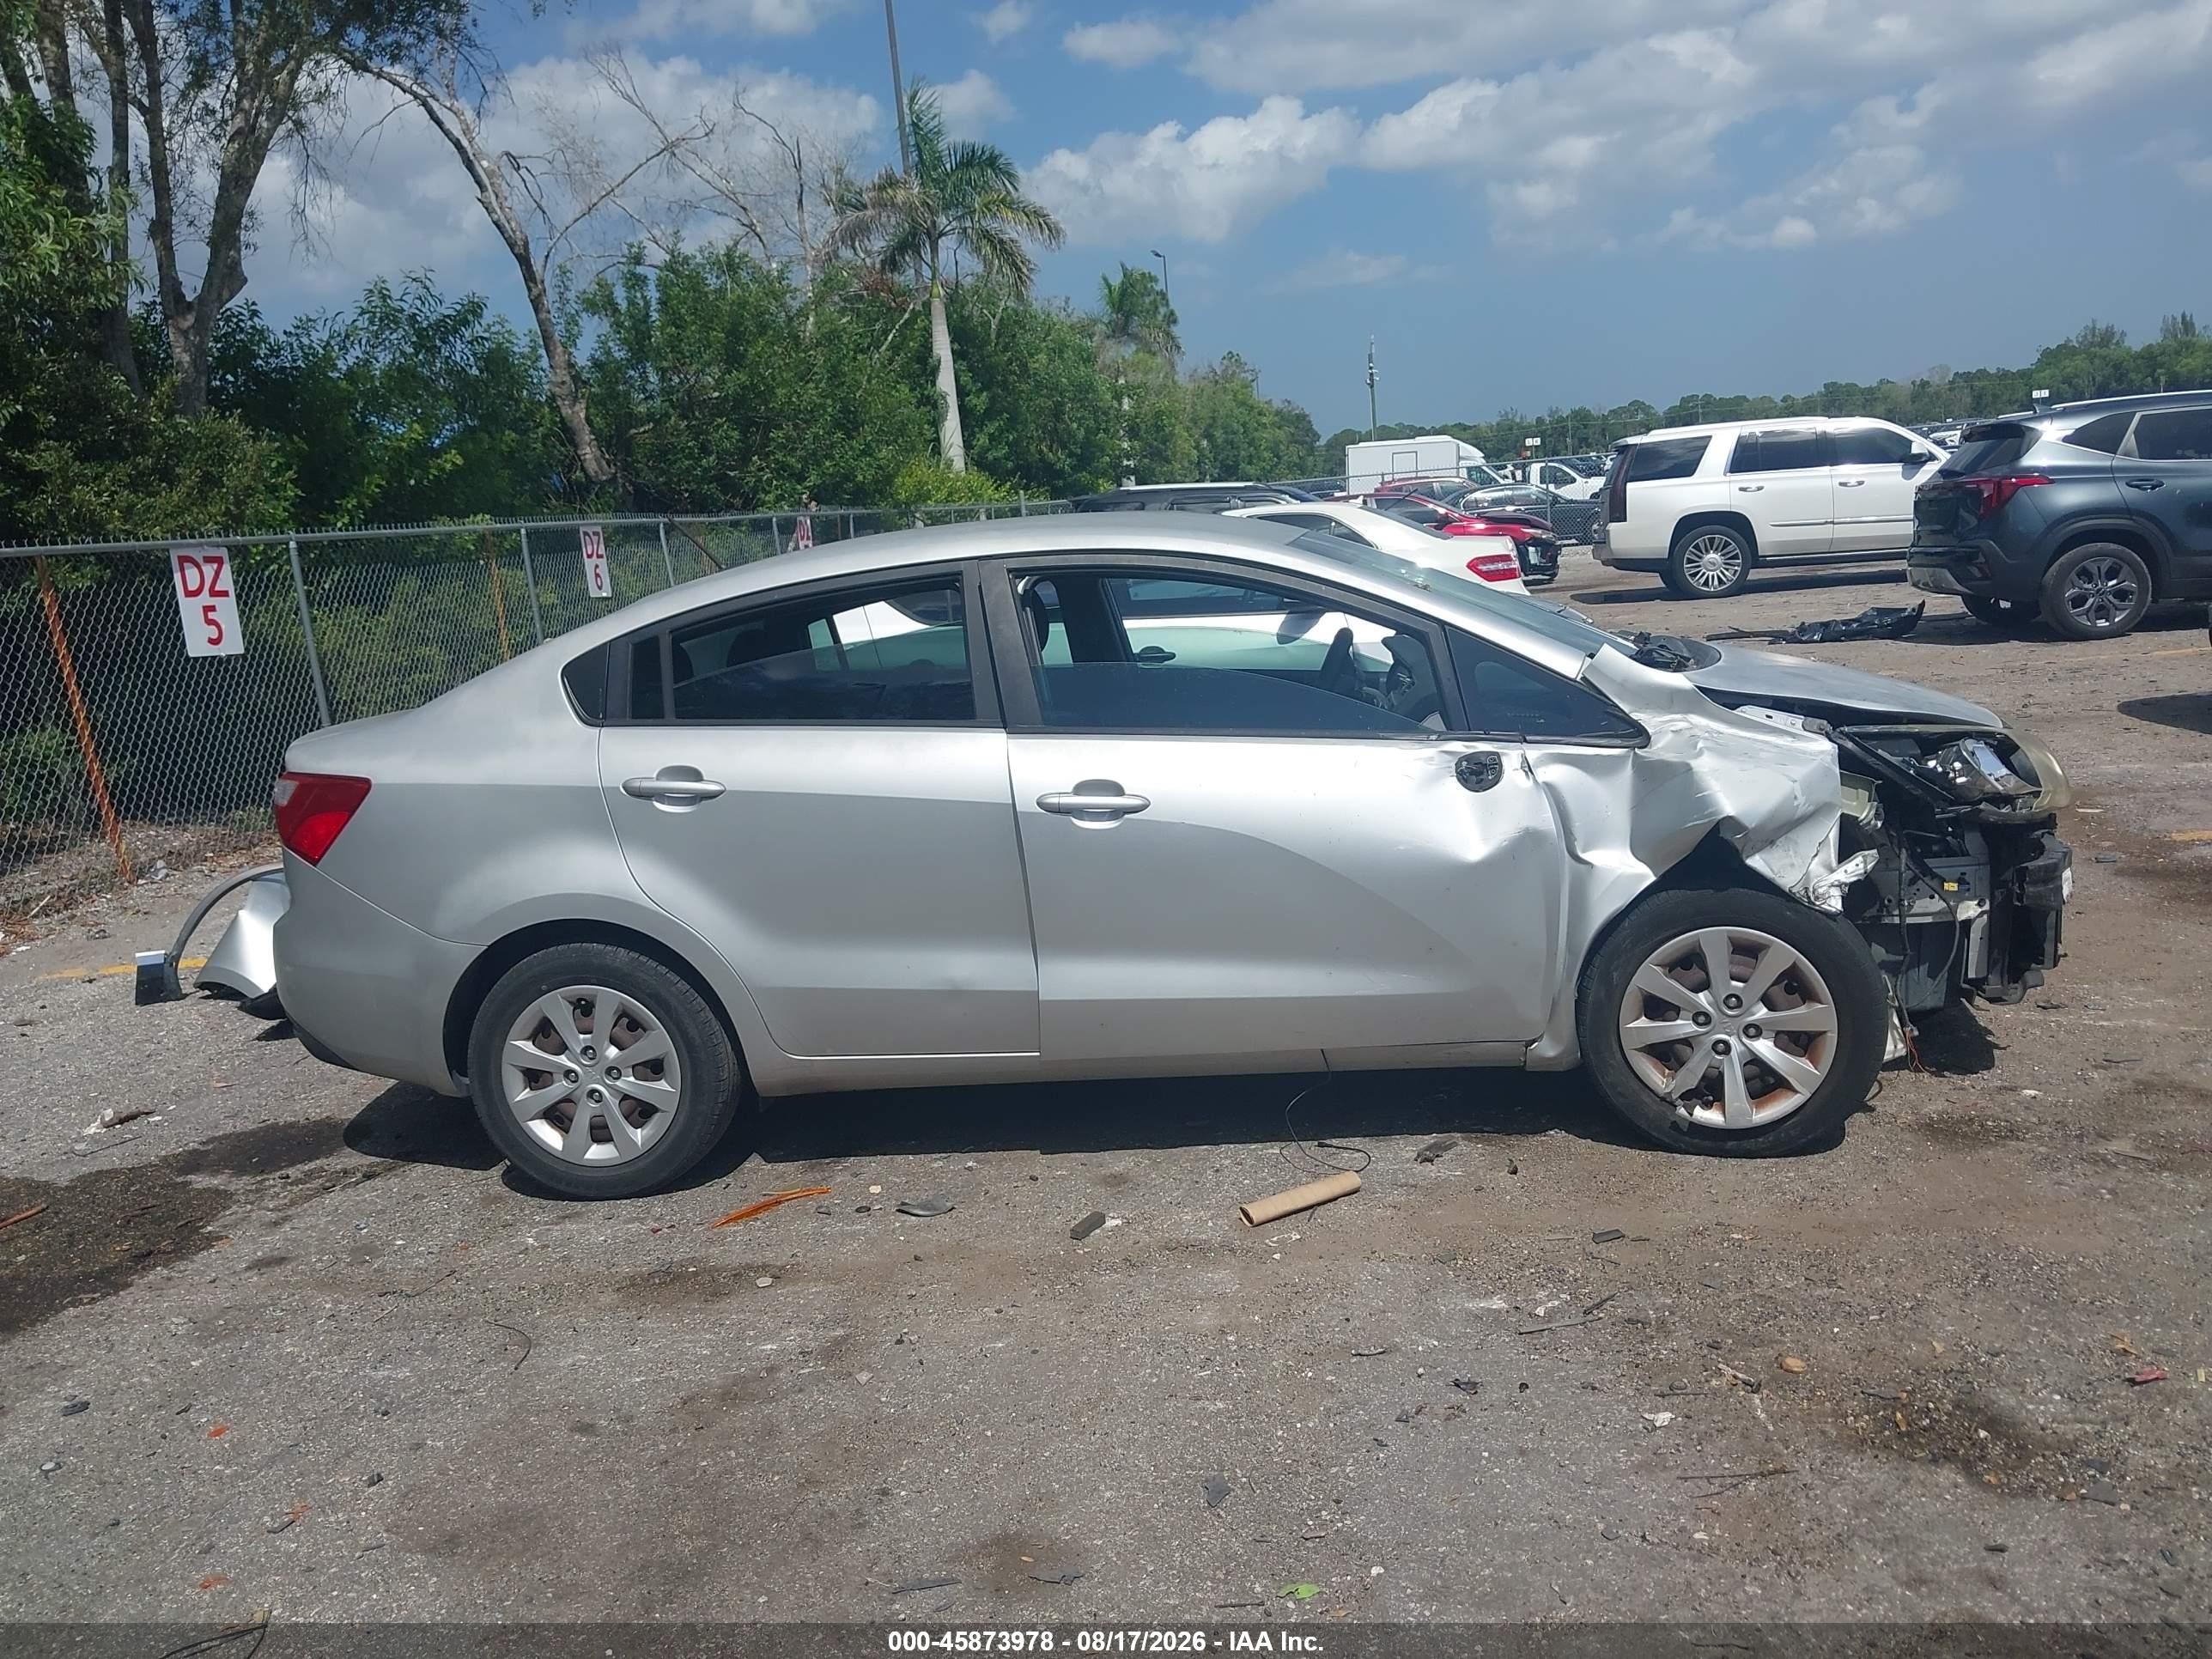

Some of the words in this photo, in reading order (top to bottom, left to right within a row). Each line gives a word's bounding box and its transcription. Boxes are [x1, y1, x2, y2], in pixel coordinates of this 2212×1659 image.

[582, 531, 605, 559] DZ
[177, 555, 230, 598] DZ
[593, 563, 604, 591] 6
[202, 605, 223, 646] 5
